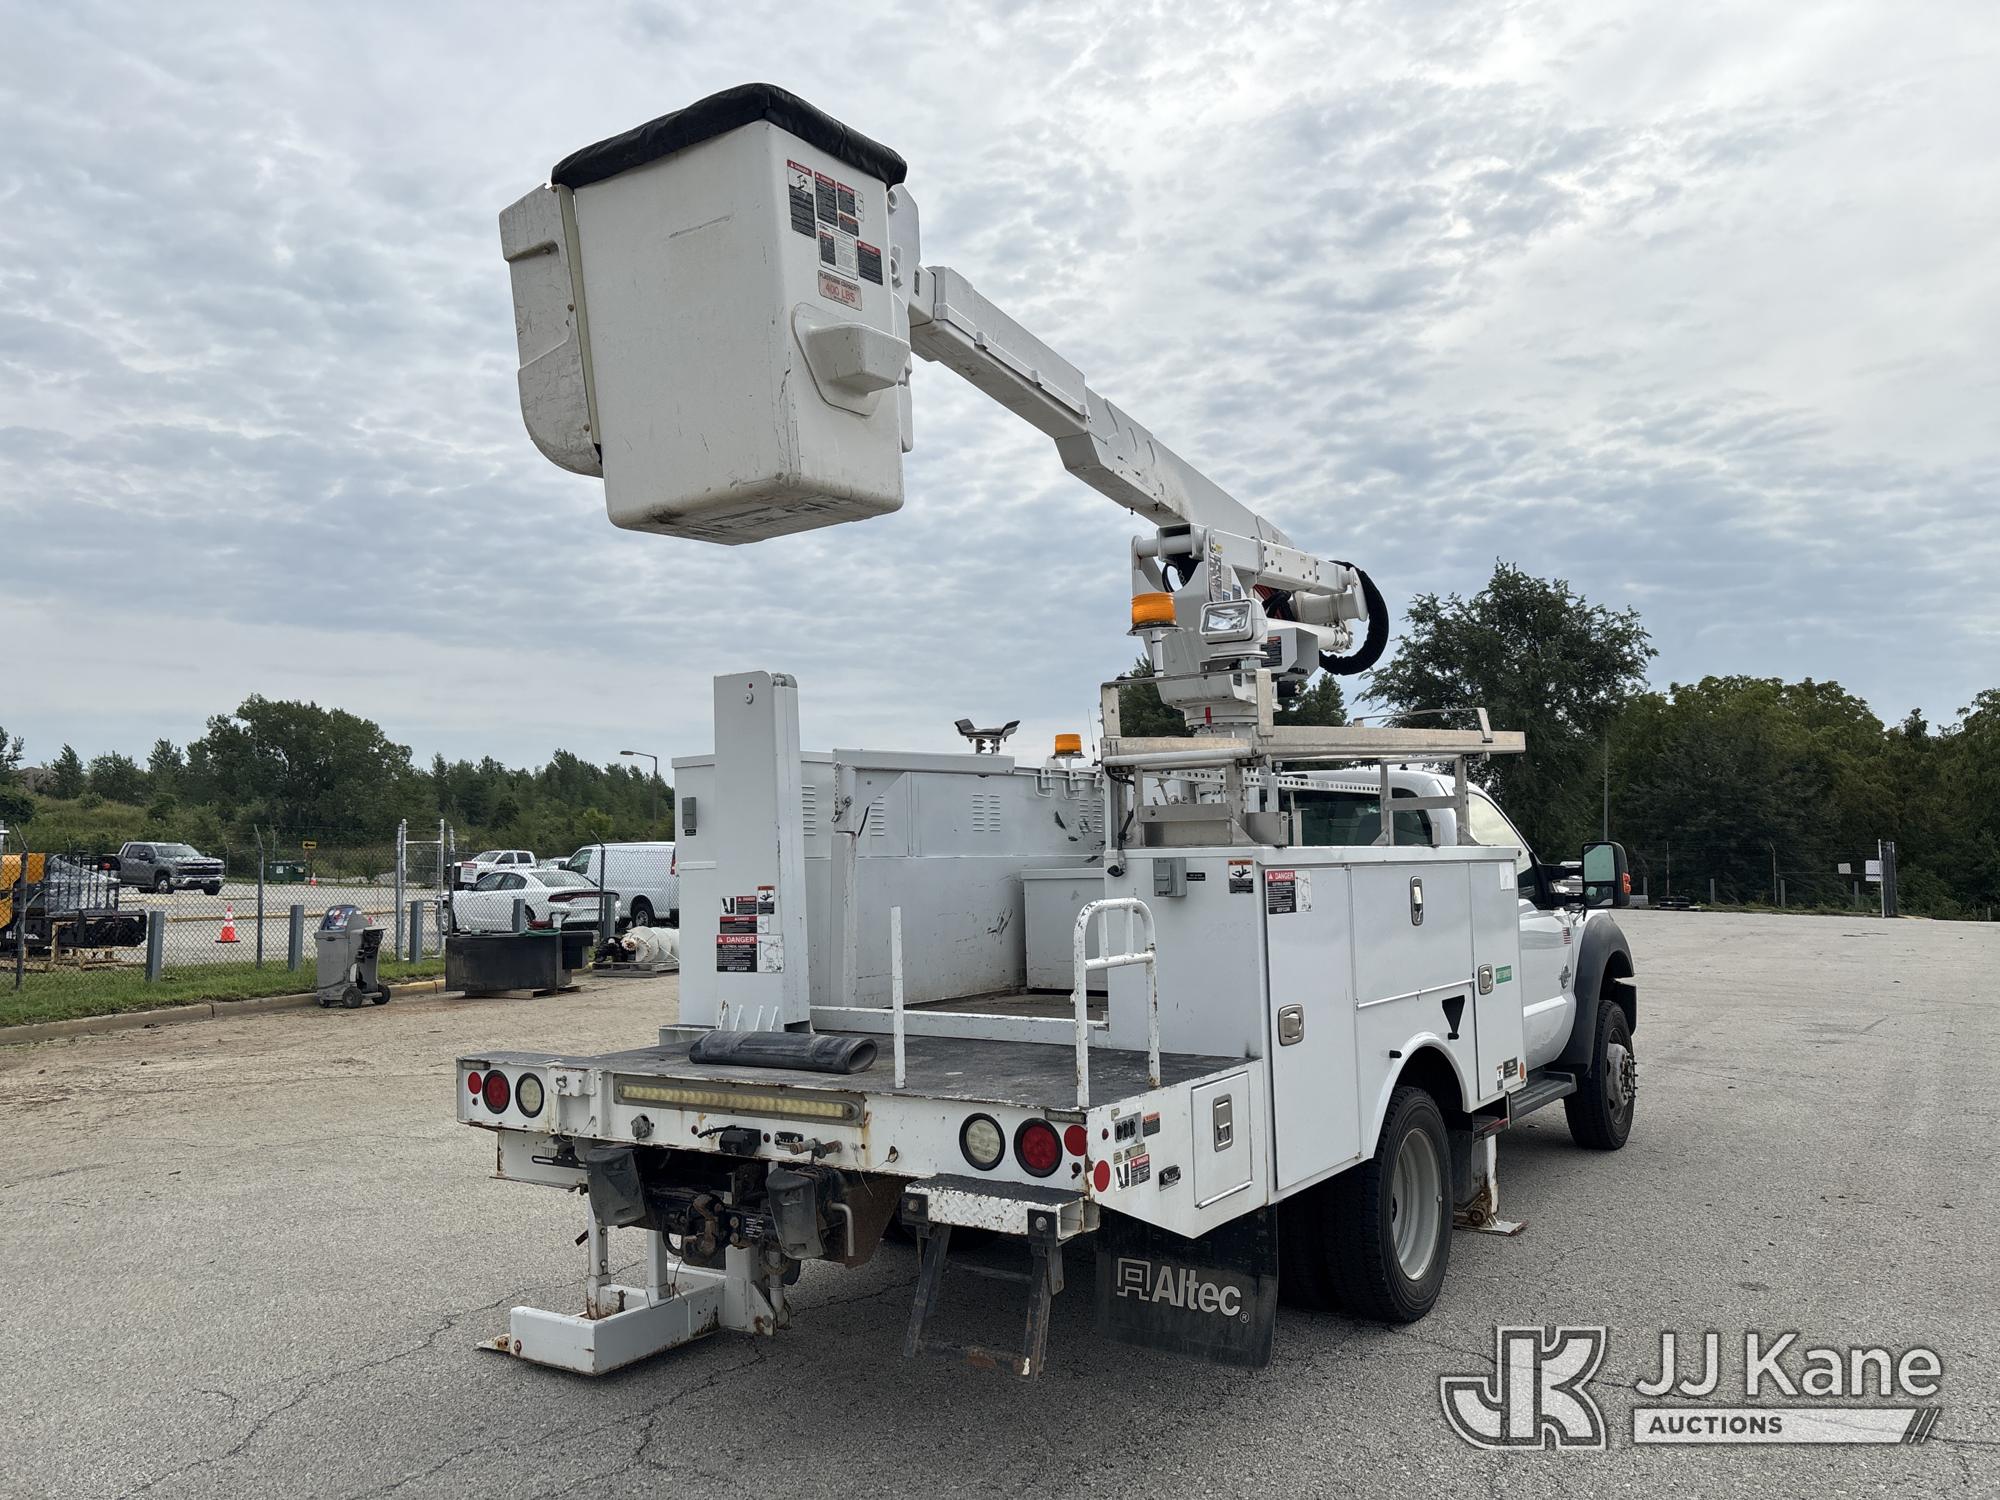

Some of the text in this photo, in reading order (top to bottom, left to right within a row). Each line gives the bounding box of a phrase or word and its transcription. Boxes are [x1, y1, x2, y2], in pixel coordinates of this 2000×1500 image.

[826, 283, 839, 296] 400
[842, 287, 855, 302] LBS
[1275, 872, 1294, 880] DANGER
[1152, 1265, 1241, 1316] Altec
